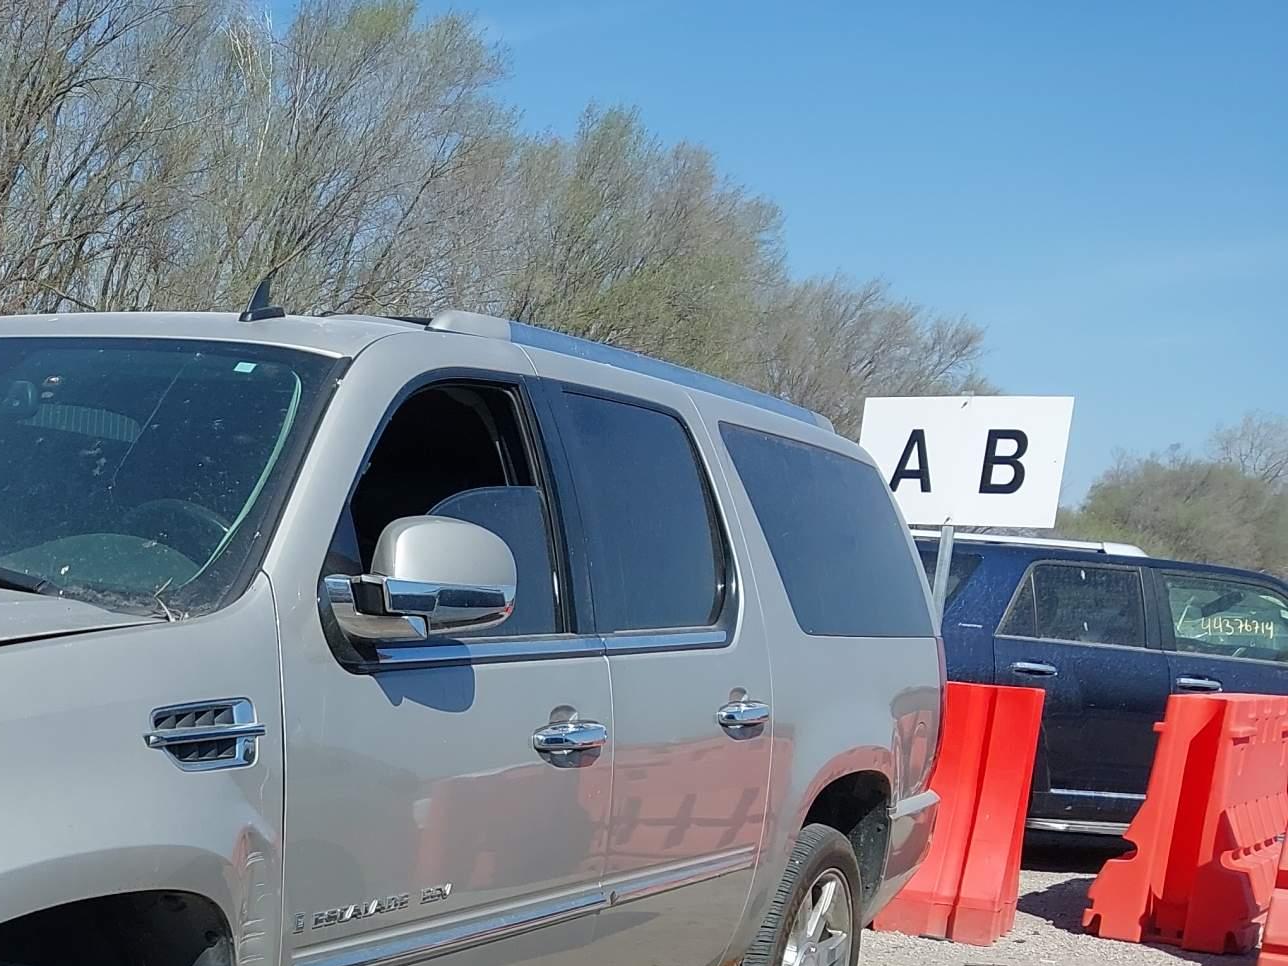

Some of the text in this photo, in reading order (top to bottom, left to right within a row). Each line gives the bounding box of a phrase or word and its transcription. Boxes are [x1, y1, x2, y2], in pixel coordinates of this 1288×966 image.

[889, 429, 1028, 494] A B
[1201, 616, 1274, 639] 44376714
[312, 893, 409, 930] ESCALADE
